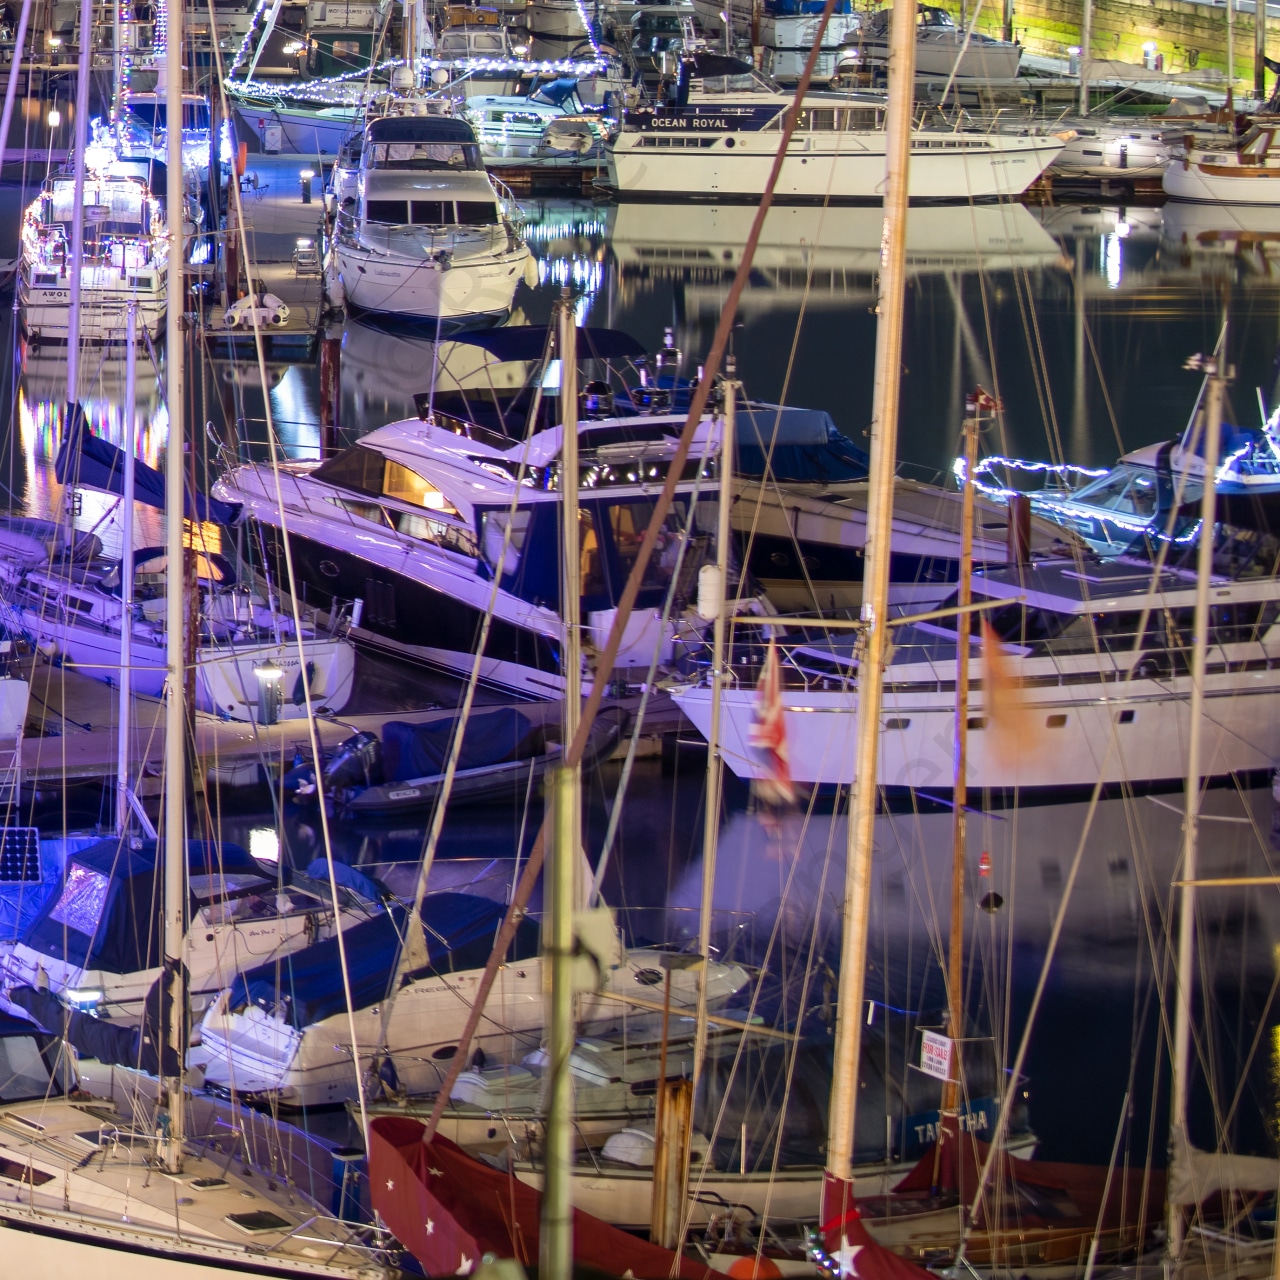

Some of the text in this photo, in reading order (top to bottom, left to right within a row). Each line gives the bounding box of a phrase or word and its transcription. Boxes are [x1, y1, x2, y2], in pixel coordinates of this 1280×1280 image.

[651, 118, 728, 128] OCEAN ROYAL
[414, 985, 463, 994] REGAL
[915, 1110, 989, 1144] TATHA
